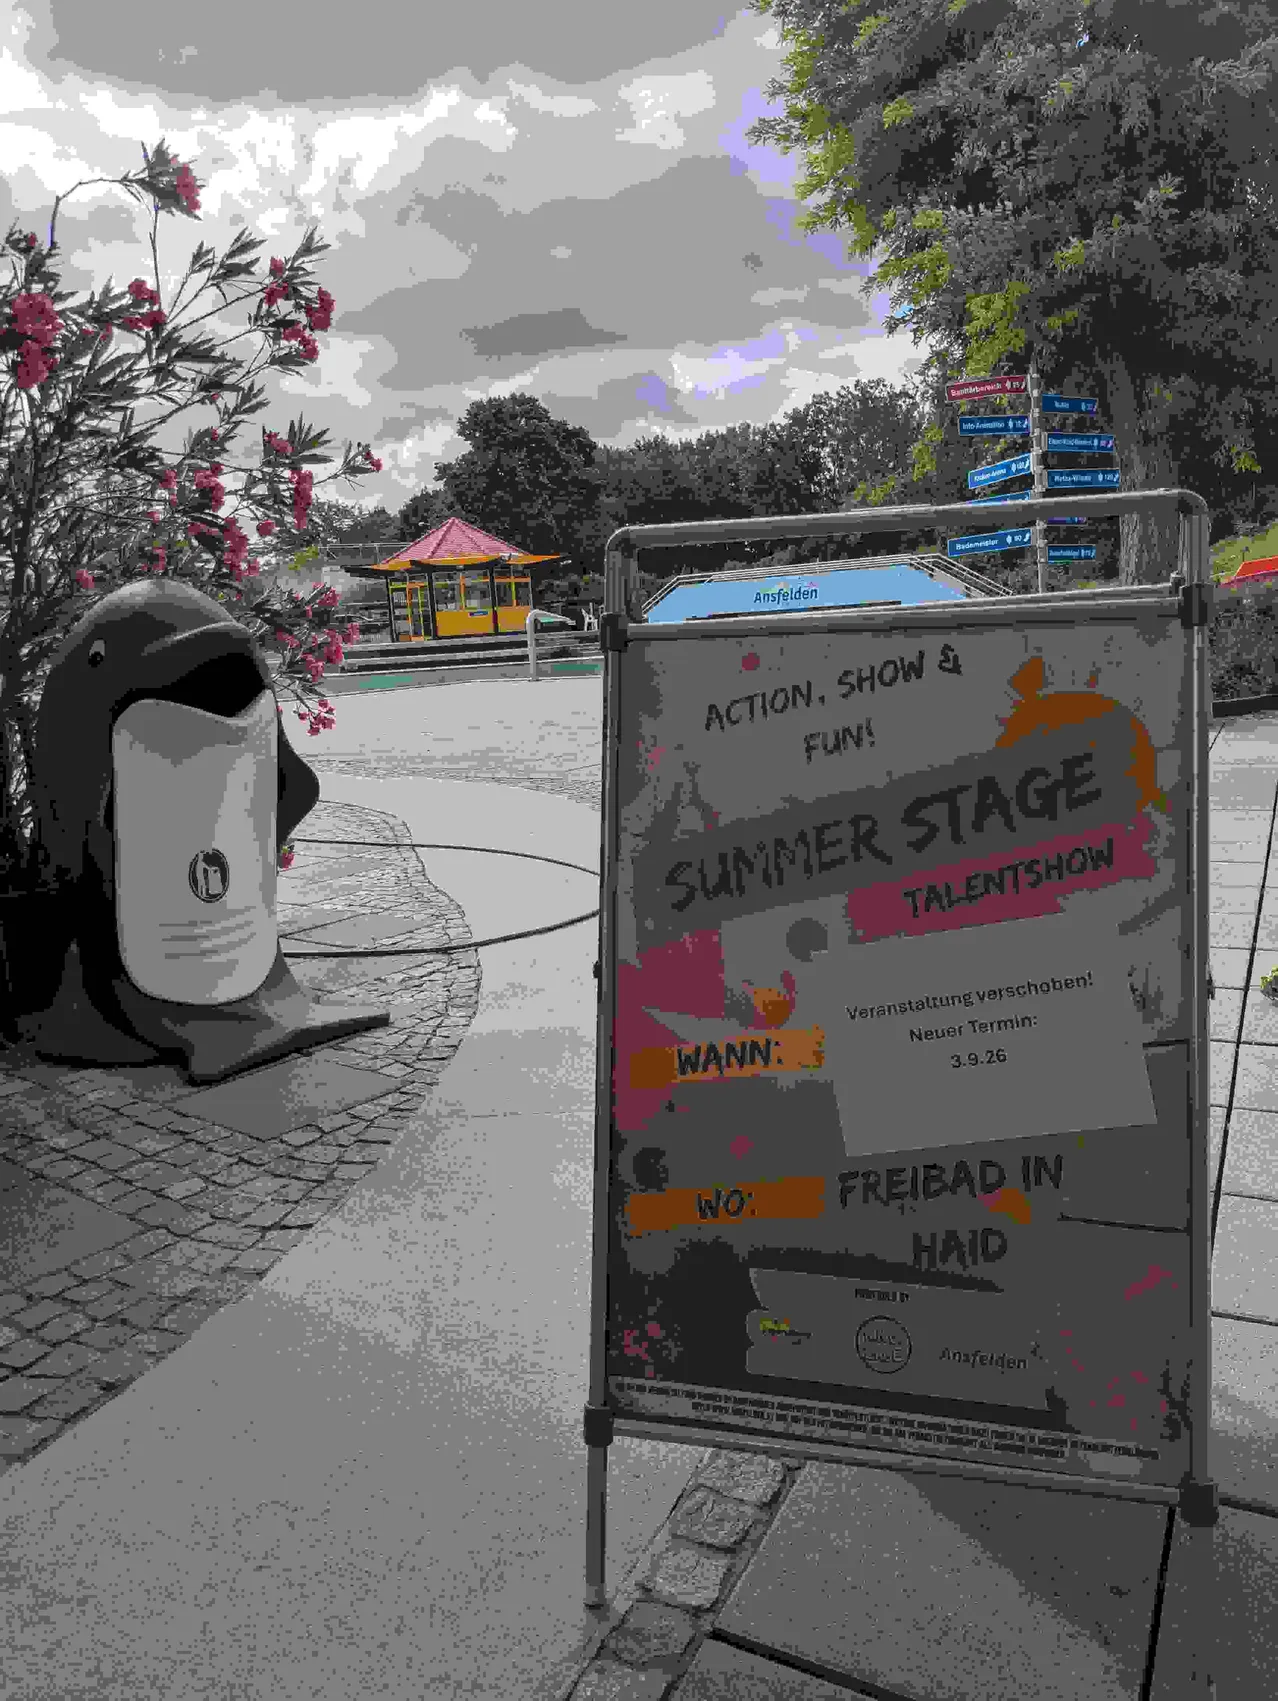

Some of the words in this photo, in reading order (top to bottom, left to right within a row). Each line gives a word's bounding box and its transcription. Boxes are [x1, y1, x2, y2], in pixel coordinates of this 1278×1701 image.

[754, 586, 818, 605] Ansfelden
[838, 650, 925, 700] SHOW
[938, 643, 963, 676] &
[804, 717, 875, 765] FUN!
[665, 814, 892, 911] SUMMER
[901, 753, 1101, 852] STAGE
[904, 838, 1114, 918] TALENTSHOW
[845, 991, 974, 1021] Veranstaltung
[976, 970, 1093, 1004] verschoben!
[909, 1024, 963, 1042] Neuer
[968, 1014, 1037, 1034] Termin:
[677, 1038, 783, 1076] WANN:
[950, 1048, 1007, 1069] 3.9.26
[837, 1159, 1006, 1208] FREIBAD
[1021, 1154, 1063, 1192] IN
[697, 1188, 757, 1220] WO:
[913, 1228, 1008, 1271] HAID
[939, 1346, 1028, 1371] Ansfelden
